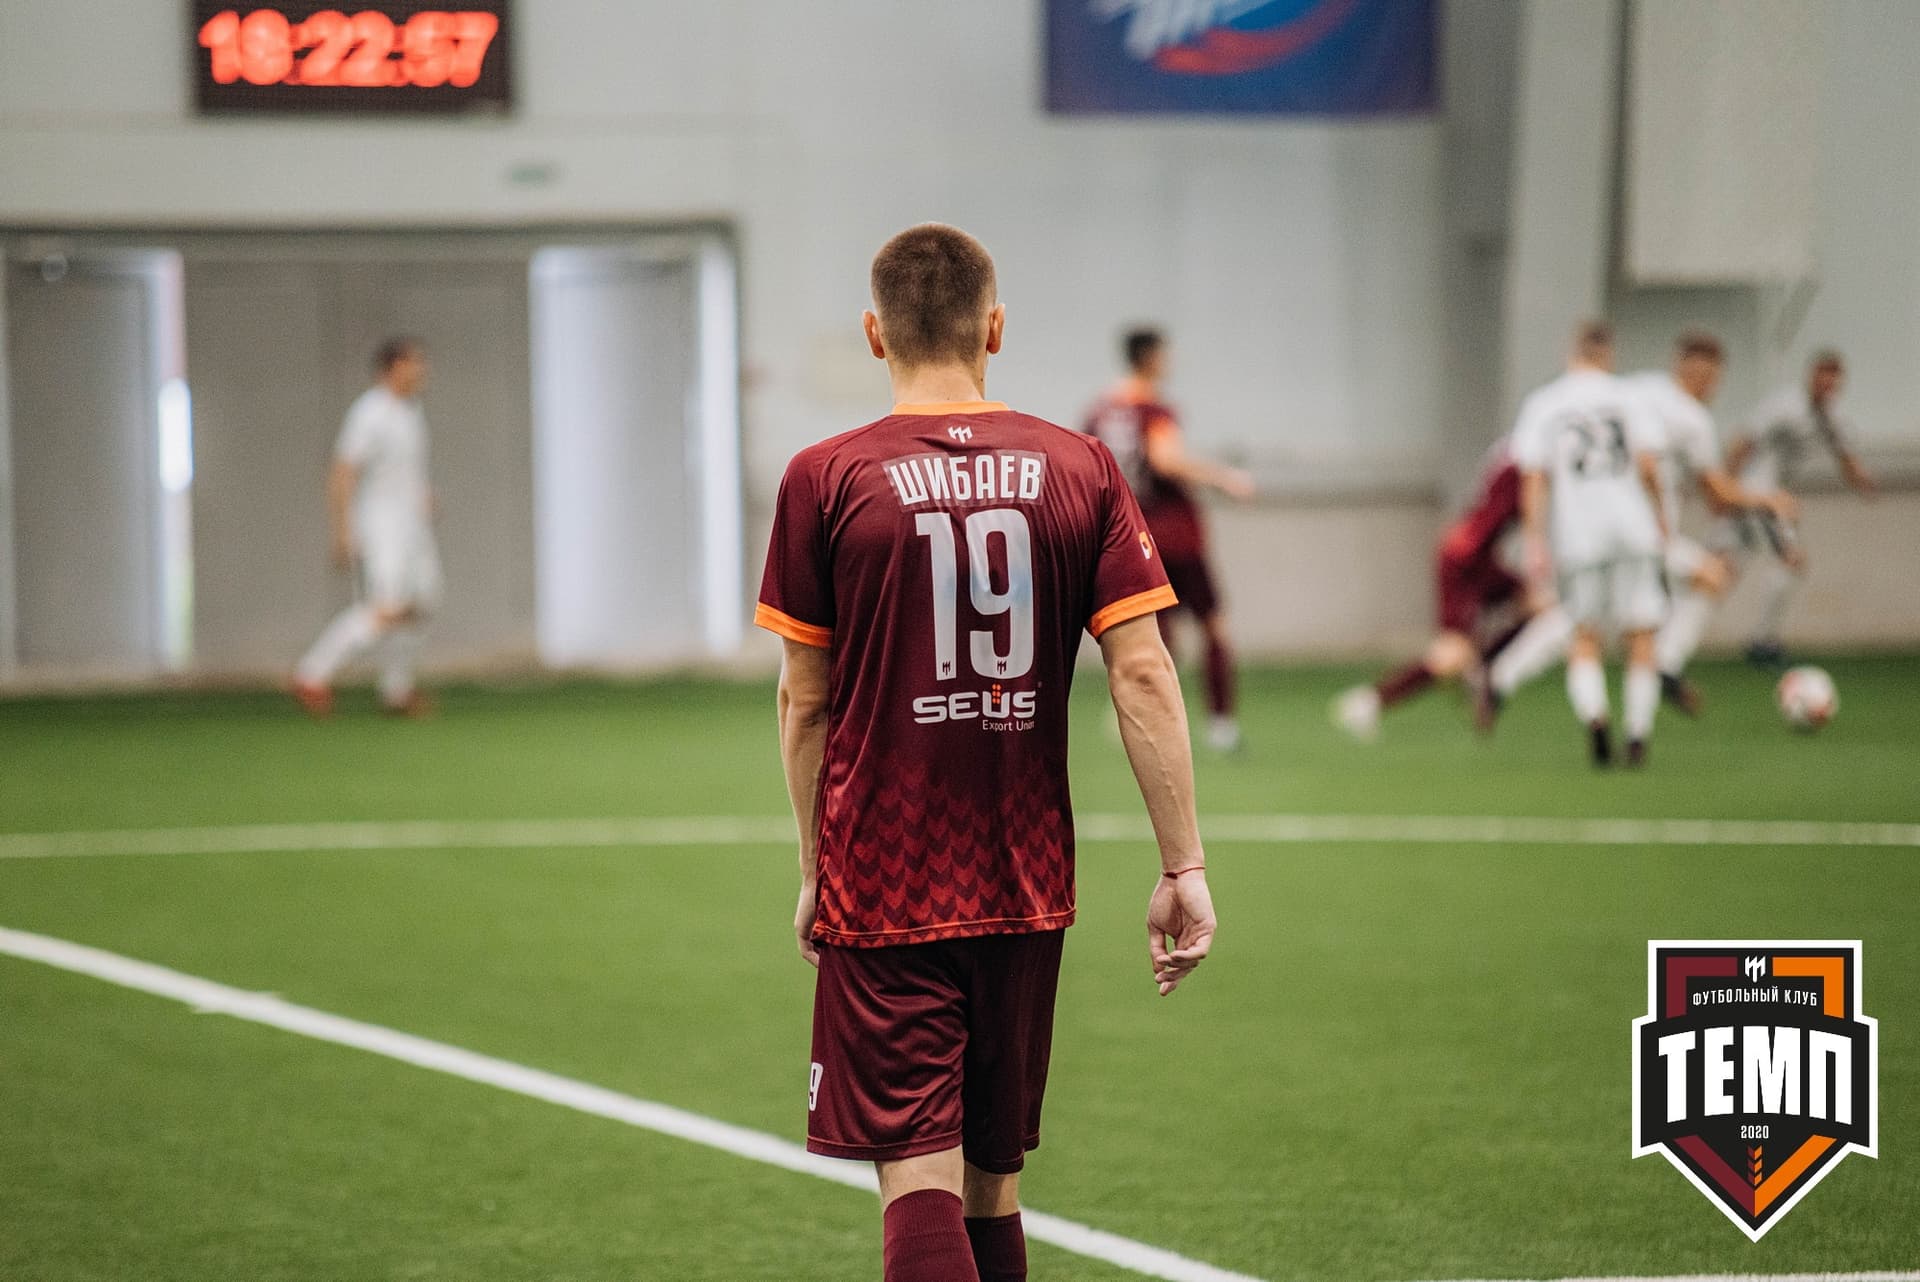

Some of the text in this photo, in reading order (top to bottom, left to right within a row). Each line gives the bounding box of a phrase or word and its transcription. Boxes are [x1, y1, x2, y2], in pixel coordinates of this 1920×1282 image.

[889, 454, 1041, 506] ШИБАЕВ
[915, 508, 1034, 681] 19
[982, 719, 1013, 732] Export
